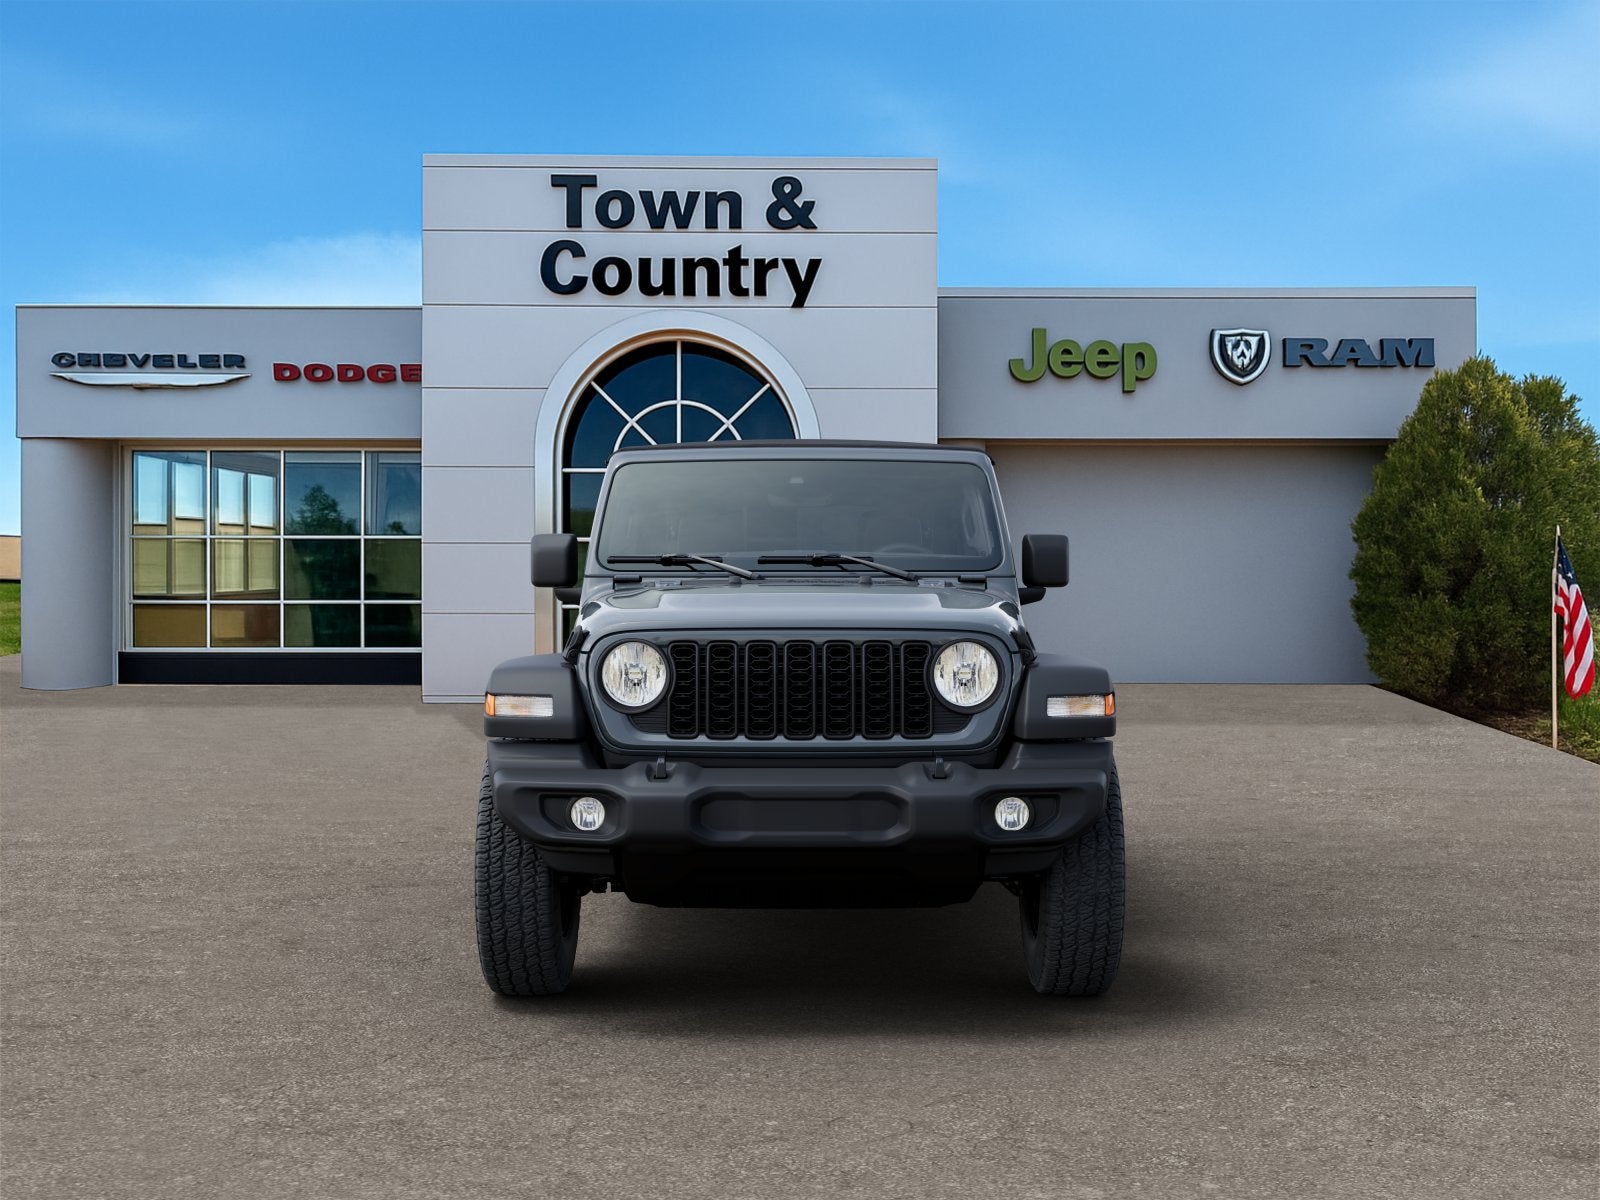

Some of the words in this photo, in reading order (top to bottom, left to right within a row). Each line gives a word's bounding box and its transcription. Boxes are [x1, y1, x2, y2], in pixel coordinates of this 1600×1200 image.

[551, 174, 742, 229] Town
[766, 176, 818, 229] &
[540, 239, 822, 308] Country
[273, 363, 422, 383] DODGE
[1009, 327, 1158, 393] Jeep
[1282, 337, 1435, 367] RAM
